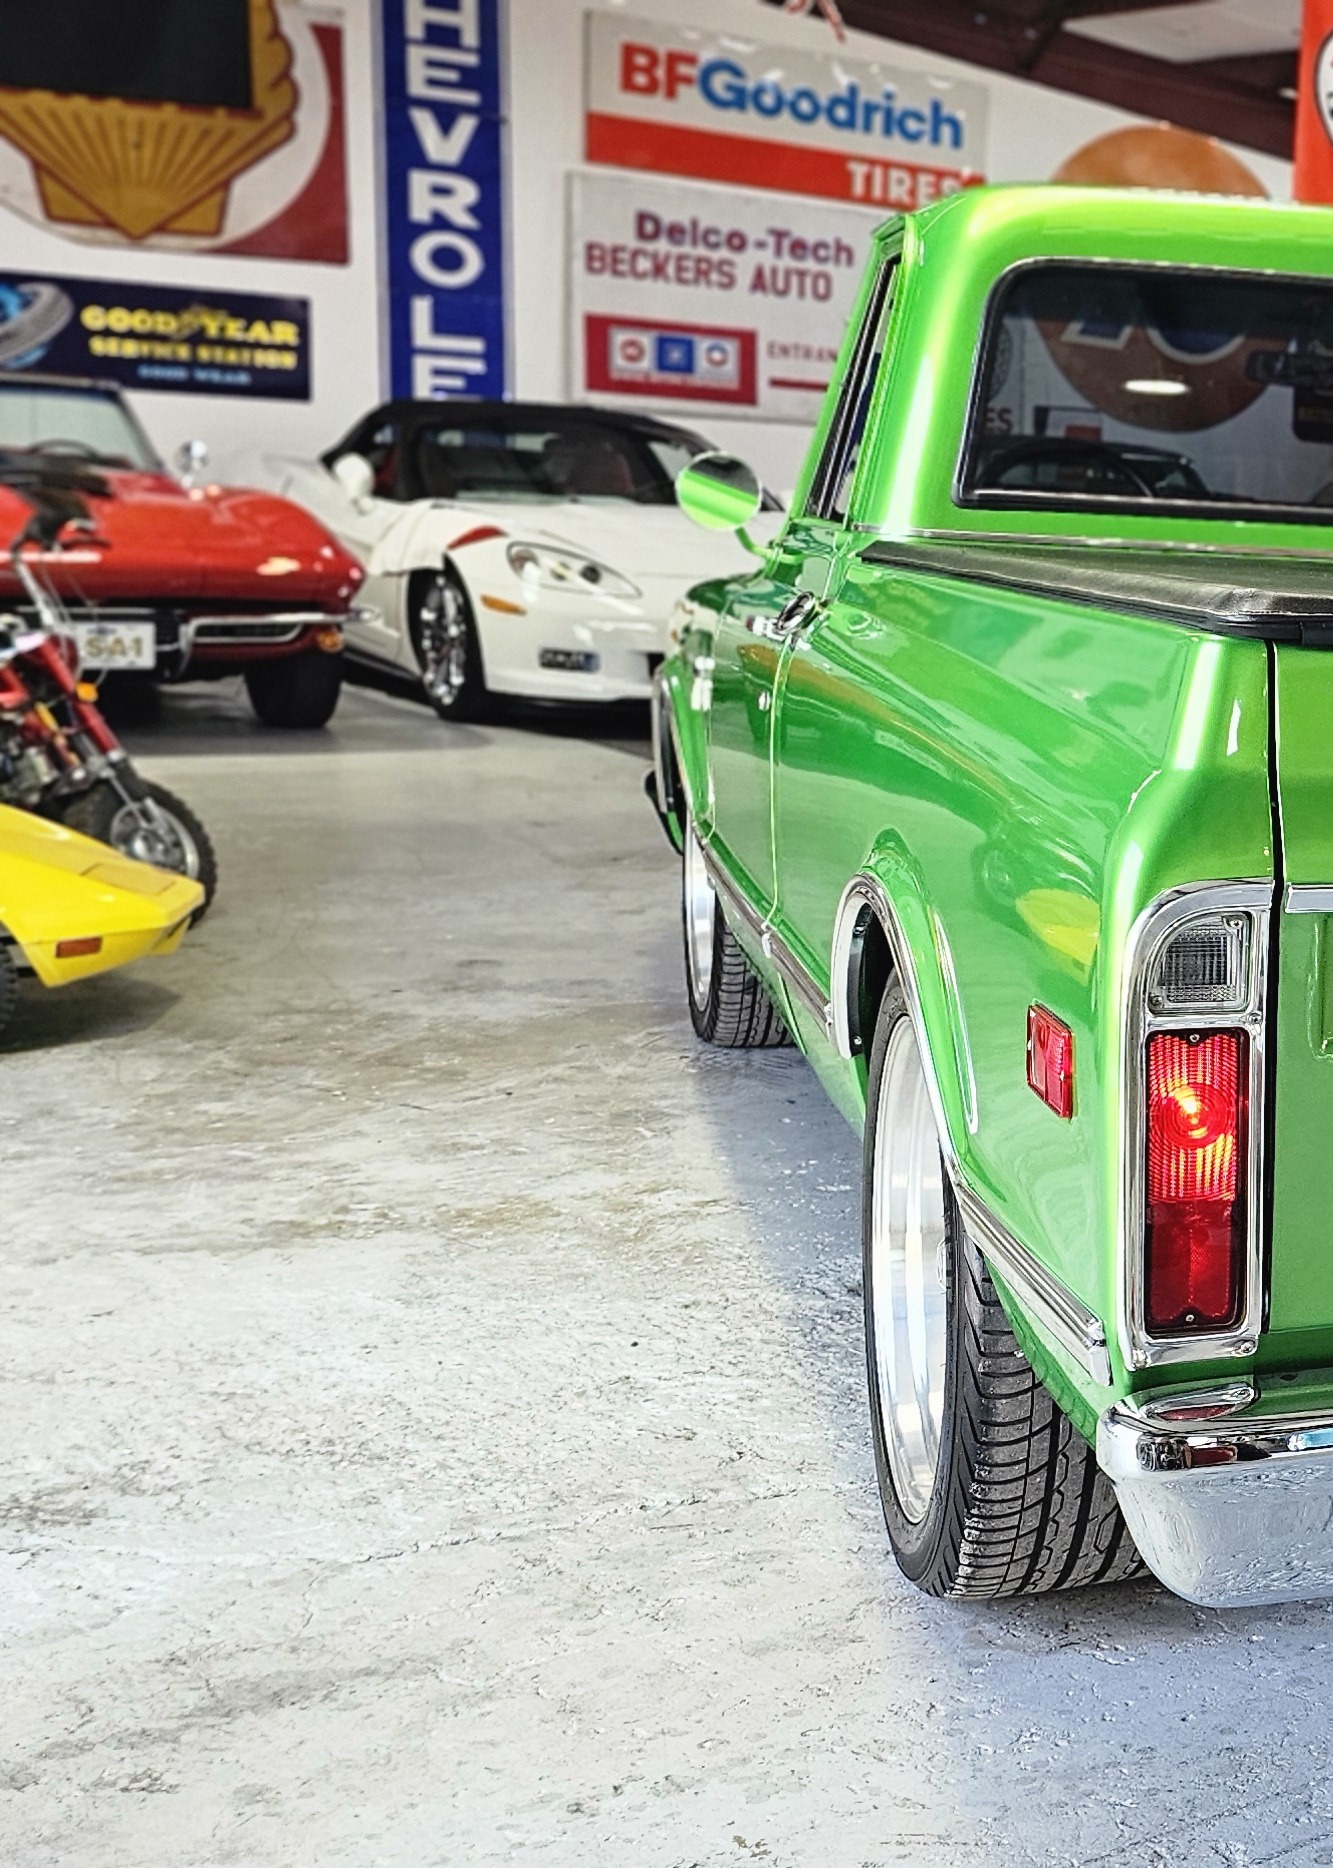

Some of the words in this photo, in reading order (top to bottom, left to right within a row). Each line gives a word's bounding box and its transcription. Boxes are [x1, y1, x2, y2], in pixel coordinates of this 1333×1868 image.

[620, 41, 963, 149] BFGoodrich
[584, 241, 737, 291] BECKERS
[750, 263, 832, 302] AUTO
[89, 336, 191, 361] SERVICE
[196, 344, 298, 370] STATION
